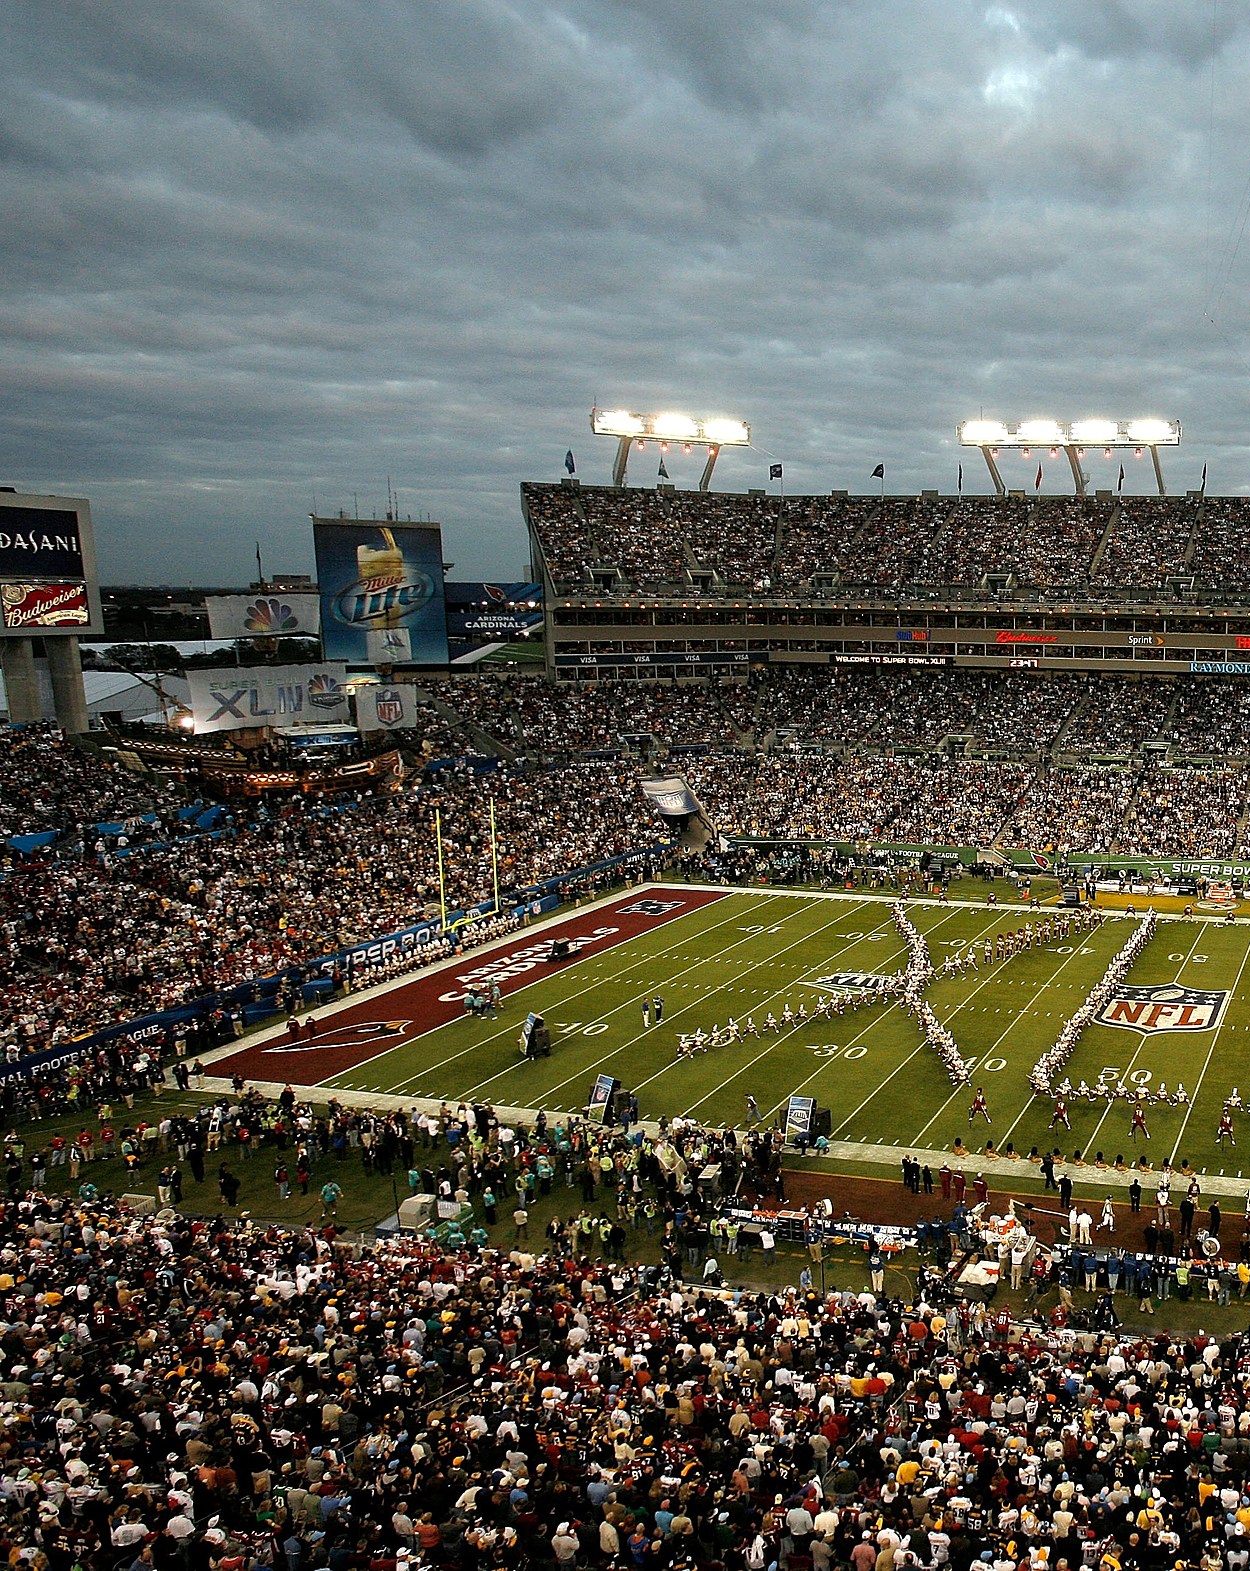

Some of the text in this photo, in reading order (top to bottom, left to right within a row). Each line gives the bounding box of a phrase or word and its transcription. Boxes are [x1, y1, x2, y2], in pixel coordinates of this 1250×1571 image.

[0, 530, 78, 553] DASANI
[359, 576, 407, 591] Miller
[4, 582, 85, 628] Budweiser
[350, 584, 422, 624] Lite
[465, 621, 528, 629] CARDINALS
[1128, 635, 1153, 645] Sprint
[634, 655, 651, 663] VISA
[835, 656, 869, 664] WELCOME
[882, 656, 907, 665] SUPER
[378, 701, 401, 721] NFL
[1172, 863, 1222, 876] SUPER
[1107, 1000, 1207, 1028] NFL
[561, 1022, 609, 1036] 10
[818, 1045, 868, 1060] 30
[31, 1047, 93, 1076] FOOTBA
[1100, 1067, 1152, 1085] 50
[96, 1314, 105, 1324] 21
[998, 1314, 1006, 1325] 81
[741, 1387, 751, 1396] 43
[844, 1408, 850, 1417] 7
[909, 1404, 915, 1413] 11
[585, 1413, 593, 1422] 7
[914, 1423, 921, 1433] 7
[967, 1518, 982, 1530] 58
[932, 1544, 939, 1554] 7
